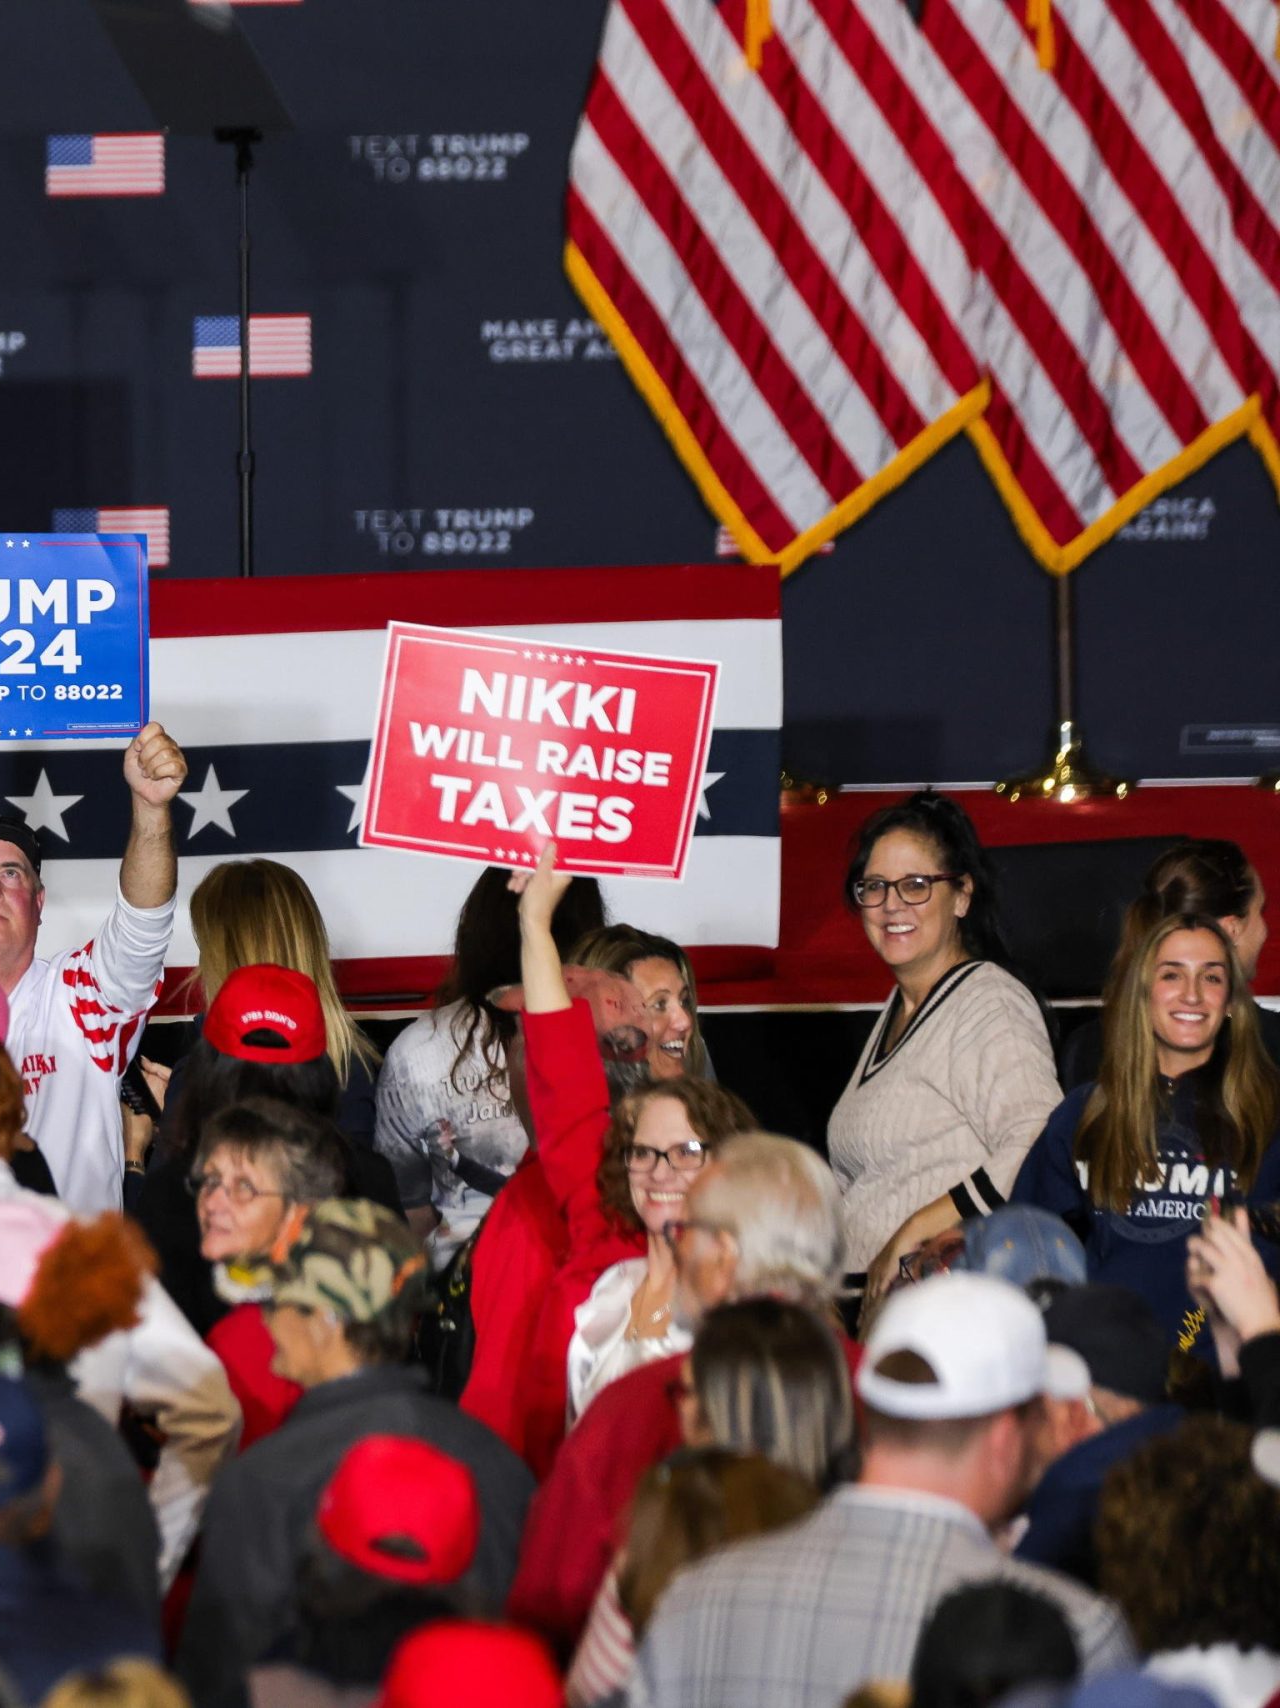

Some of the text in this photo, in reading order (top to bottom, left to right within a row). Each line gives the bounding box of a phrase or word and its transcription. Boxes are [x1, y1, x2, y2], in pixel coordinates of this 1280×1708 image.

[348, 132, 529, 160] TEXT TRUMP
[372, 156, 410, 182] TO
[481, 319, 557, 341] MAKE
[489, 338, 574, 362] GREAT
[354, 507, 534, 533] TEXT TRUMP
[378, 532, 415, 555] TO
[17, 685, 46, 701] TO
[54, 684, 123, 700] 88022
[459, 667, 637, 735] NIKKI
[408, 721, 673, 787] WILL RAISE
[430, 773, 636, 844] TAXES
[1135, 1199, 1207, 1220] AMERIC
